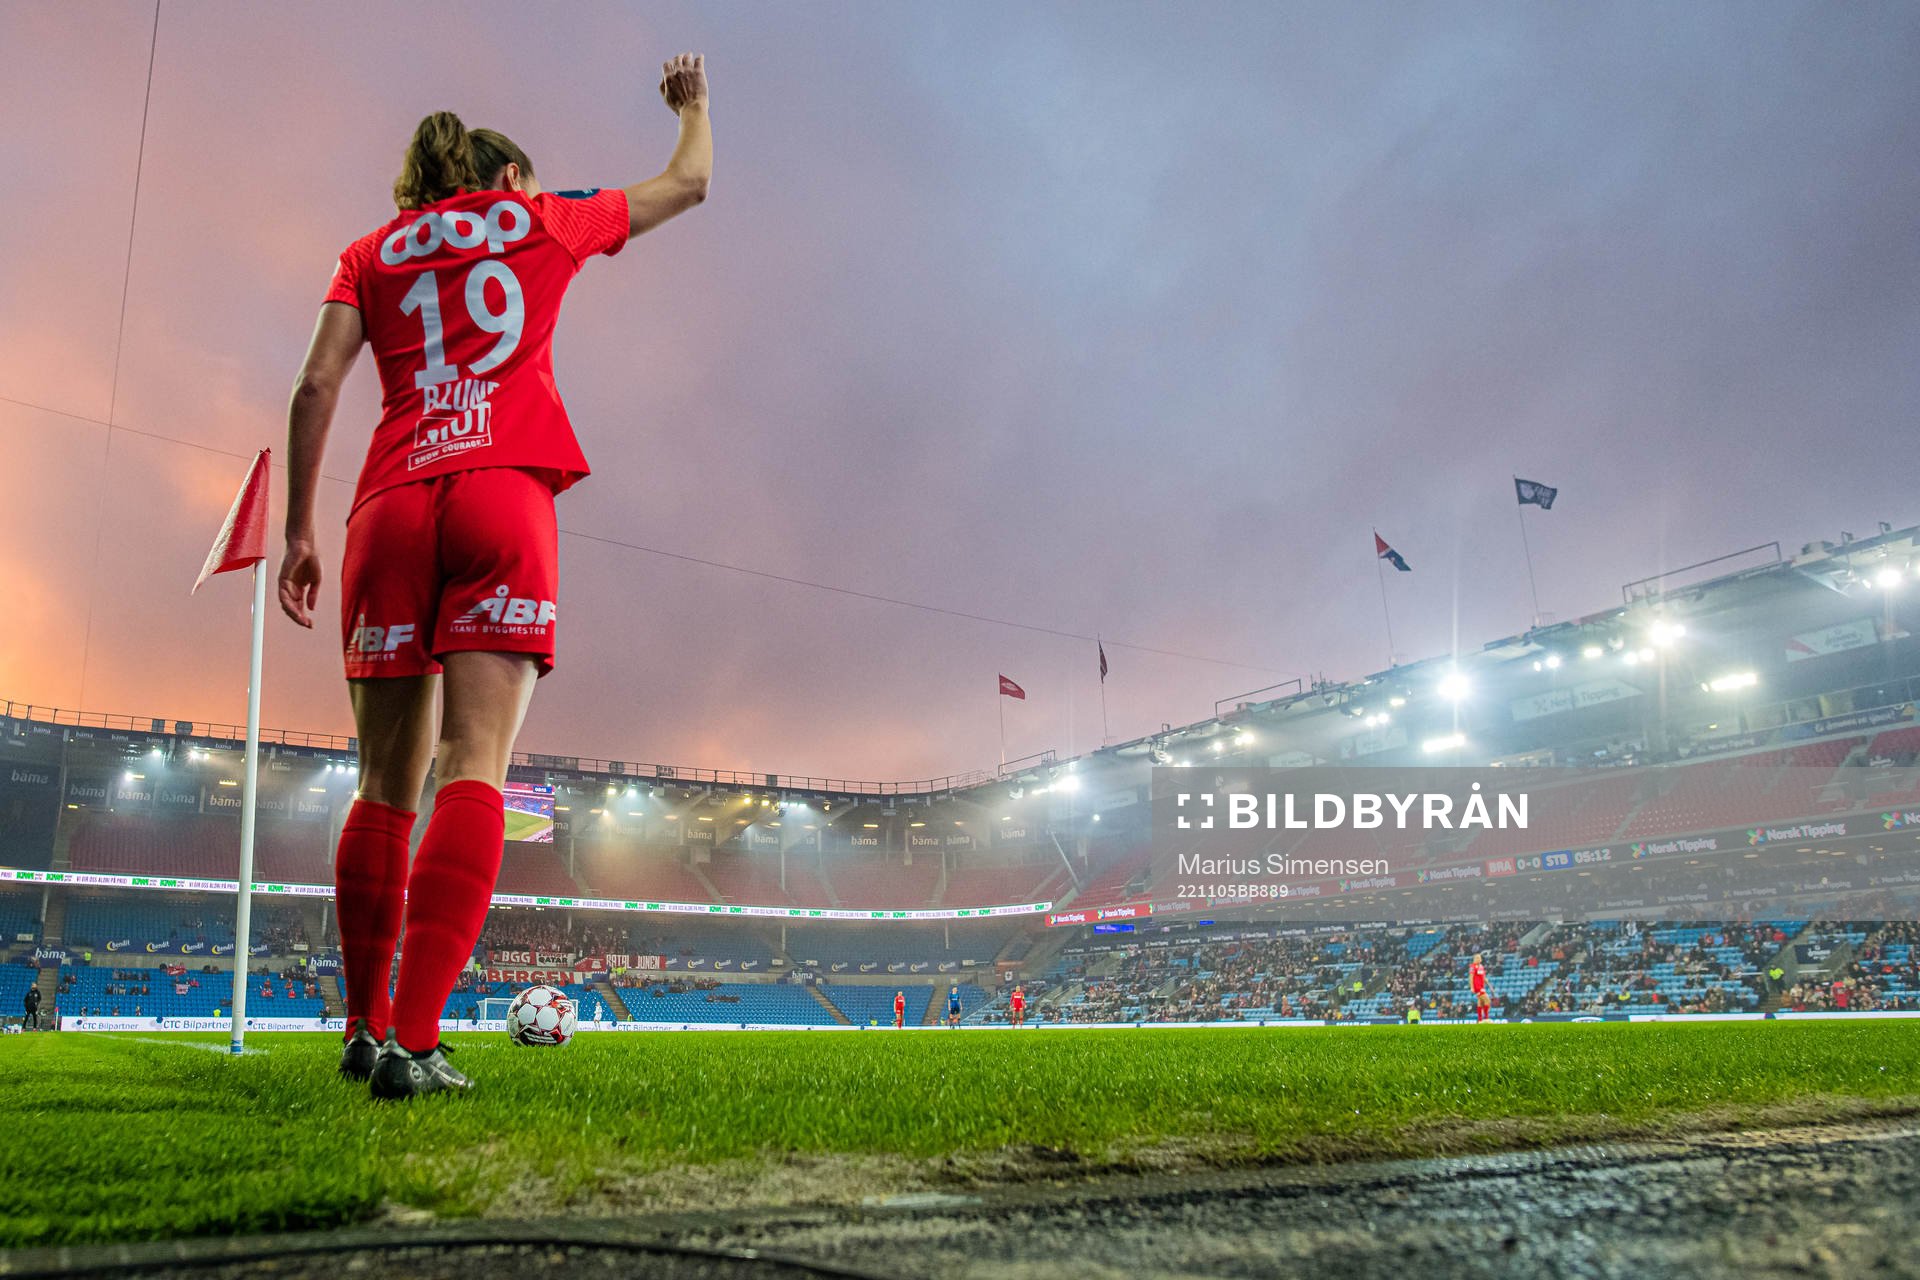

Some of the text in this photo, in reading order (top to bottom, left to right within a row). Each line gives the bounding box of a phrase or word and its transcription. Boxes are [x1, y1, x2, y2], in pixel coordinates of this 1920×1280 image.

[380, 200, 531, 265] coop
[399, 259, 525, 390] 19
[415, 450, 439, 465] SHOW
[483, 625, 546, 635] BYGGMESTER
[209, 794, 242, 808] bama
[1766, 822, 1846, 841] Norsk Tipping
[851, 836, 878, 846] bama
[912, 835, 939, 846] bama
[1647, 838, 1717, 854] Norsk Tipping
[1546, 853, 1569, 867] STB
[1574, 848, 1612, 864] 05:12
[1488, 860, 1512, 873] BRA
[1517, 856, 1541, 870] 0-0
[1430, 866, 1482, 880] Norsk Tipping
[1903, 873, 1920, 881] Tipp
[35, 947, 66, 960] bama
[502, 950, 531, 963] BGG
[311, 956, 338, 968] bama
[487, 968, 575, 984] BERGEN
[791, 970, 813, 980] bama
[82, 1022, 140, 1031] CTC Bilpartner
[163, 1020, 233, 1031] CTC Bilpartner
[267, 1023, 305, 1031] Bilpartner
[327, 1021, 343, 1029] CTC
